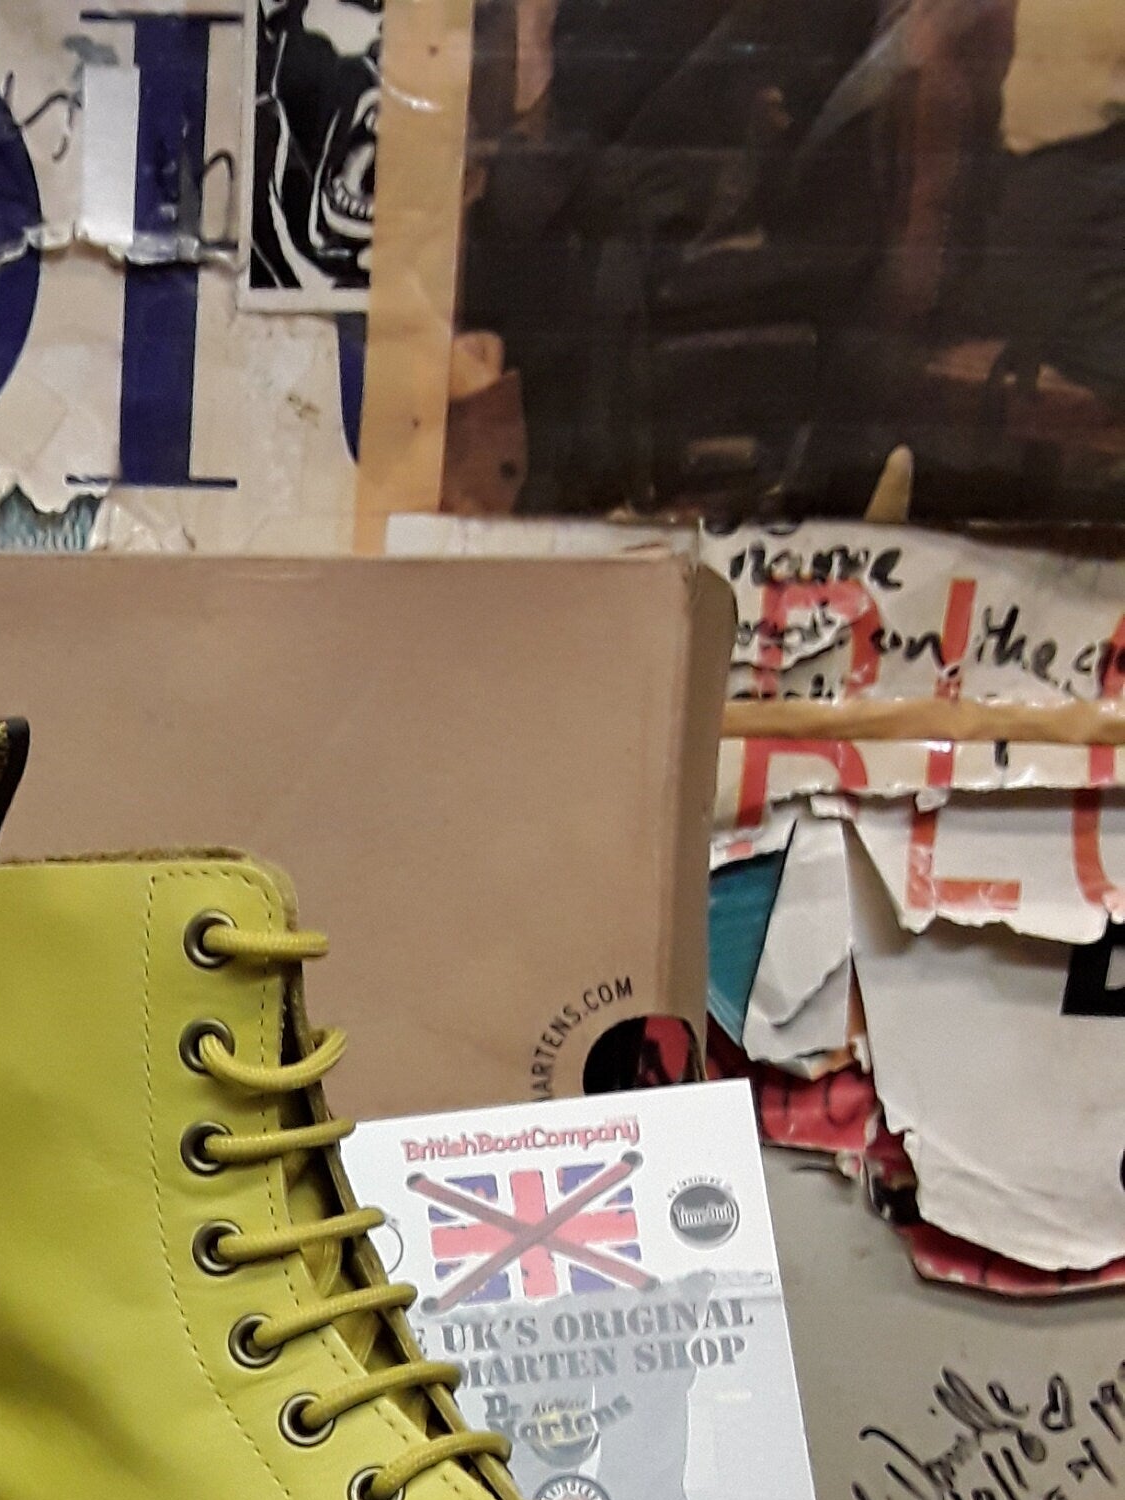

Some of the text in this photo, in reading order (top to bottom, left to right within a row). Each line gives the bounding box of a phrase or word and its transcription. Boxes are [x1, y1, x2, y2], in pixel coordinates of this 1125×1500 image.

[531, 975, 633, 1102] ARTENS.COM
[401, 1115, 641, 1163] BritishBootCompany
[441, 1316, 540, 1352] UK'S
[551, 1299, 754, 1344] ORIGINAL
[633, 1335, 746, 1374] SHOP
